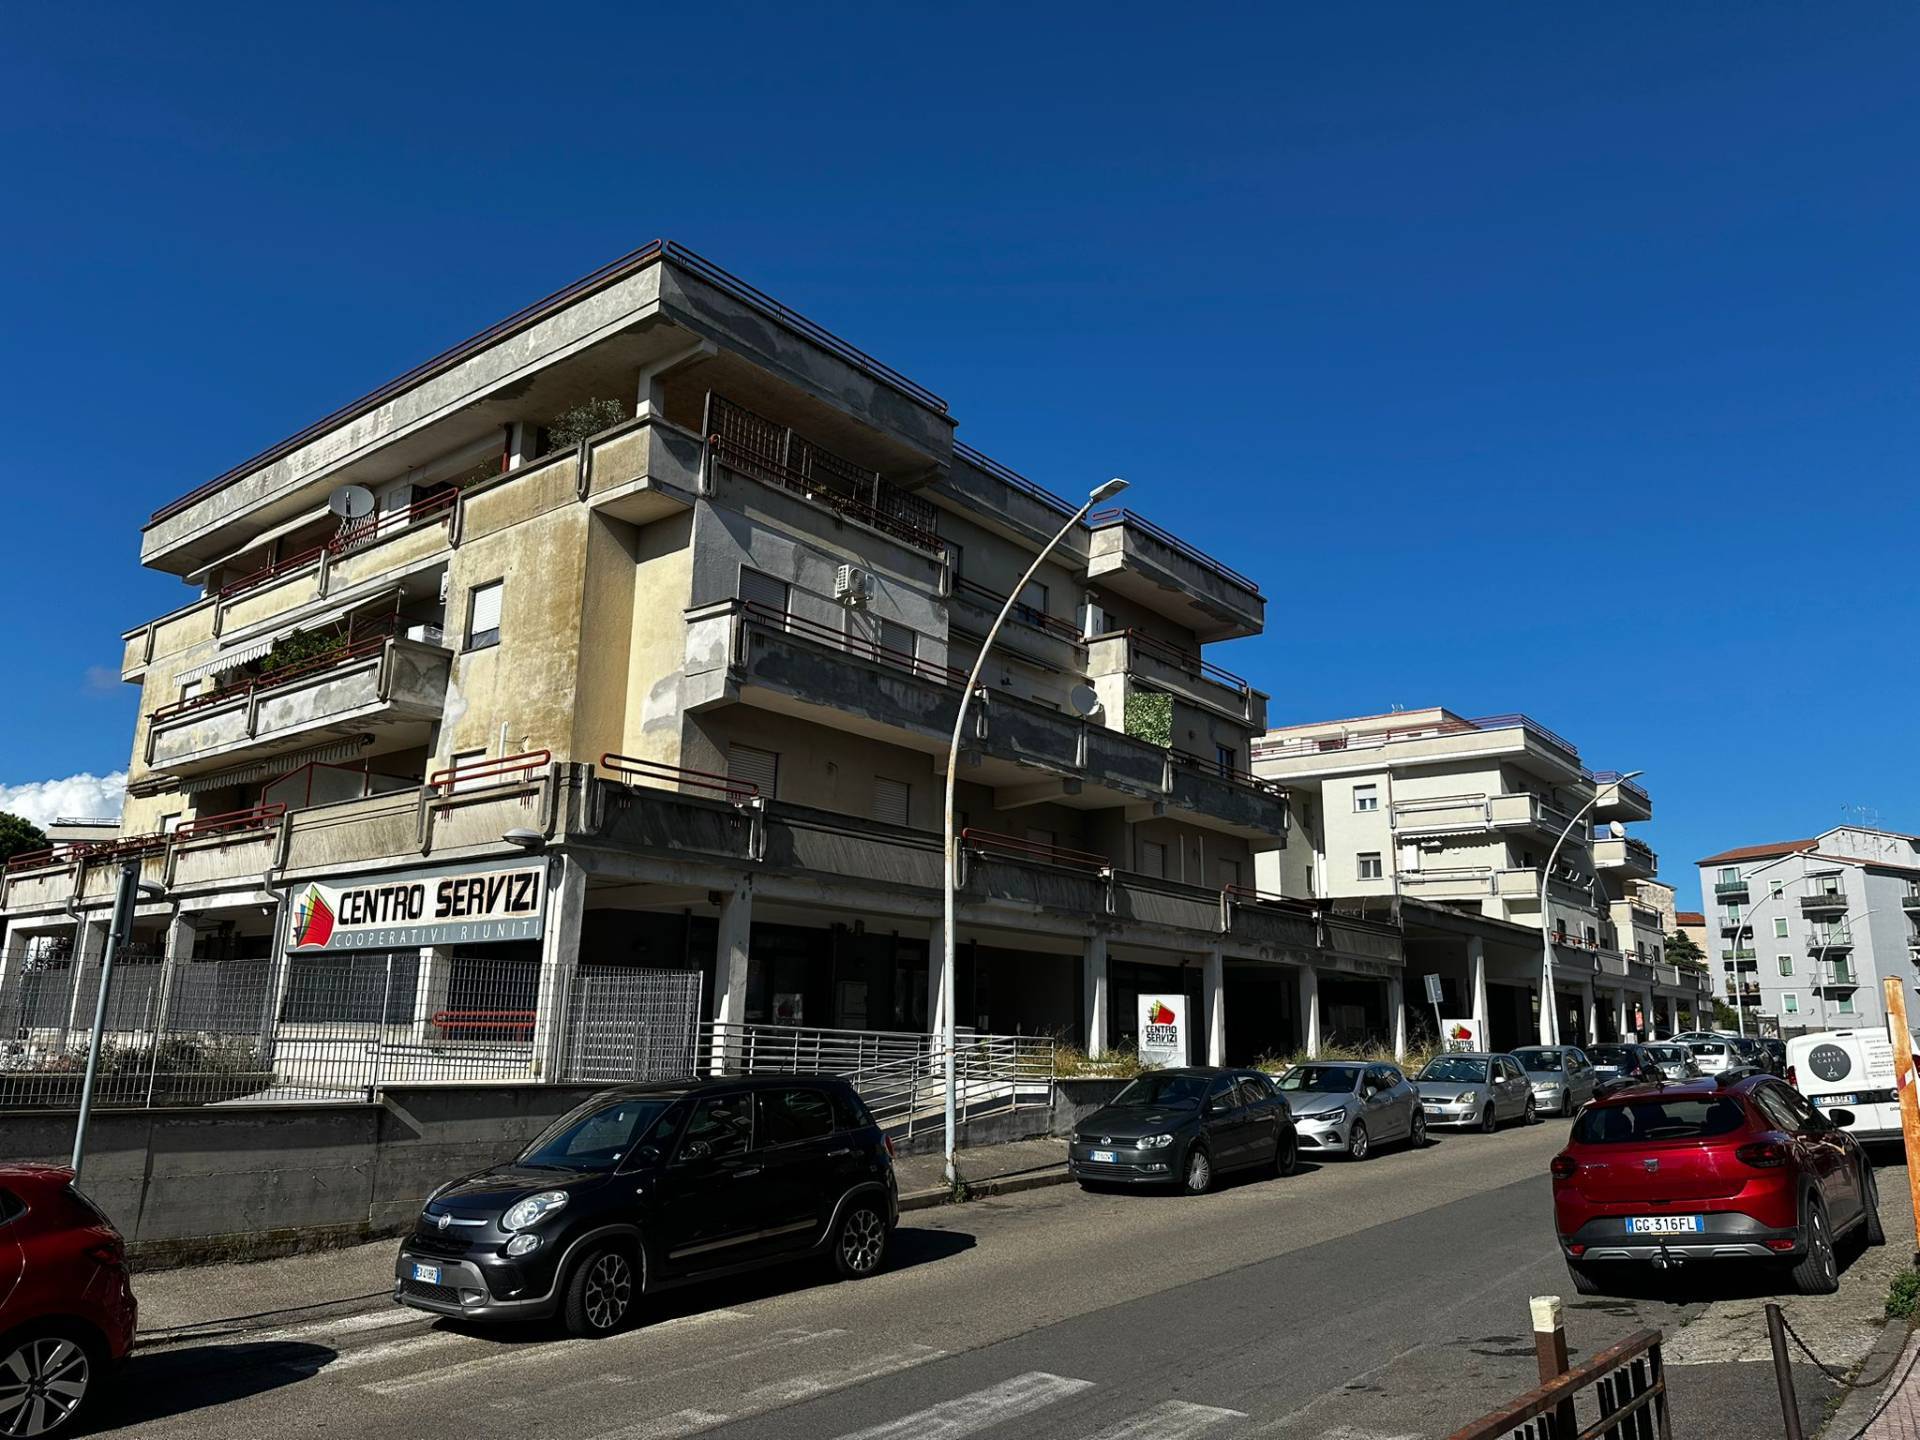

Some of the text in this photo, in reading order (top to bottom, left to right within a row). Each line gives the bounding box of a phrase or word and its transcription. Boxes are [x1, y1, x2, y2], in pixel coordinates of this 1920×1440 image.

[338, 871, 541, 925] CENTRO SERVIZI
[335, 920, 540, 948] COOPERATIVI RIUNITI
[1146, 1025, 1177, 1034] CENTRO
[1146, 1033, 1178, 1043] SERVIZI
